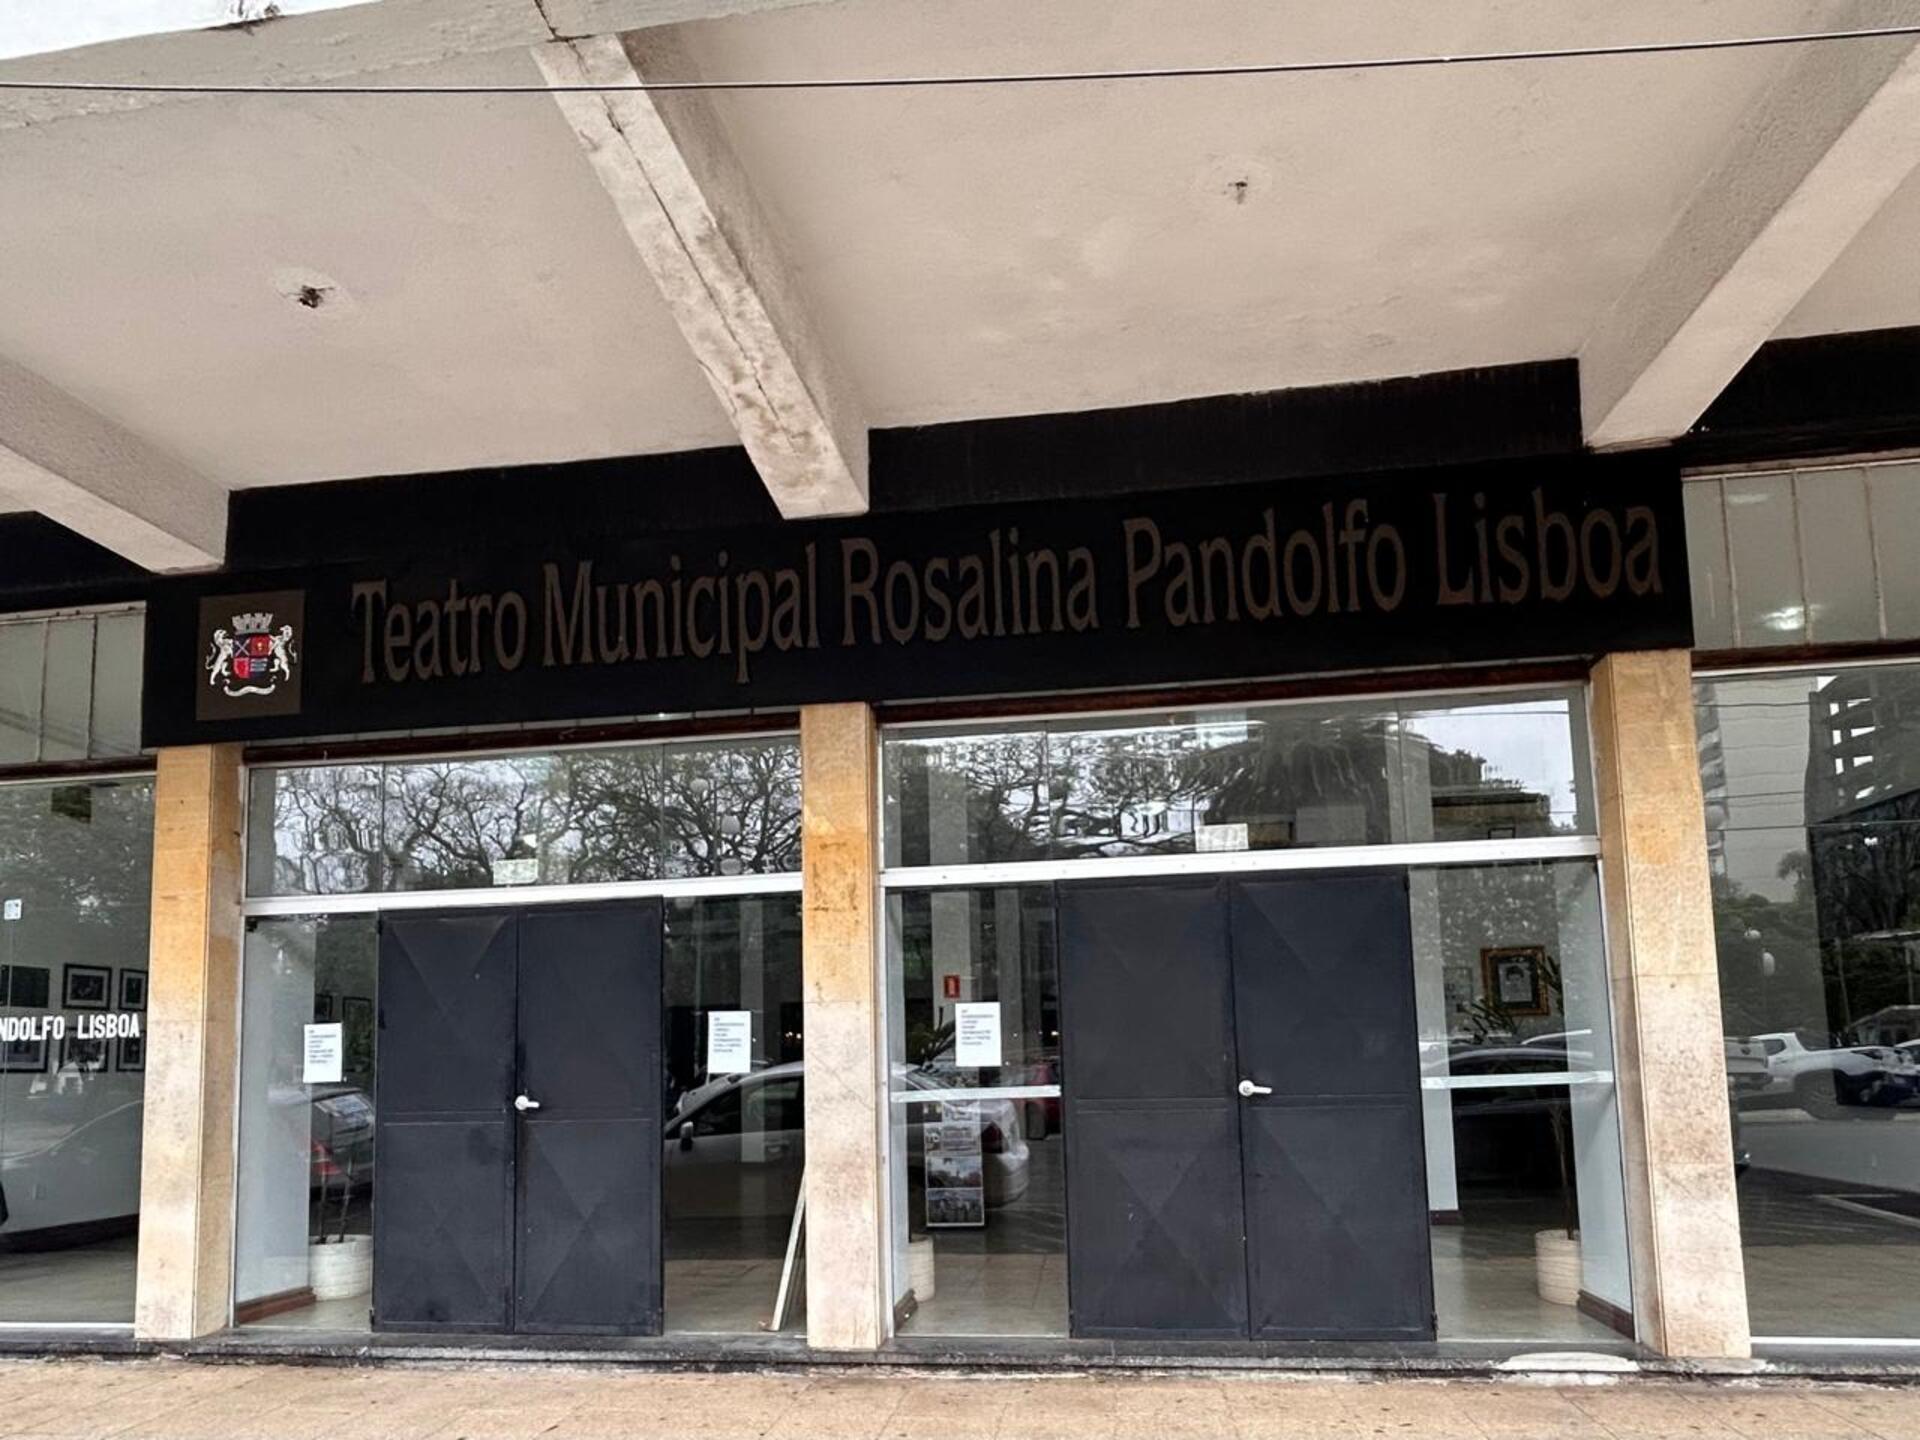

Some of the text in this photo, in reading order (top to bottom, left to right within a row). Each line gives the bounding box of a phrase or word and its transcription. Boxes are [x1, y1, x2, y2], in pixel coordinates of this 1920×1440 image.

[351, 487, 1662, 684] Teatro Municipal Rosalina Pandolfo Lisboa
[77, 1013, 140, 1039] LISBOA
